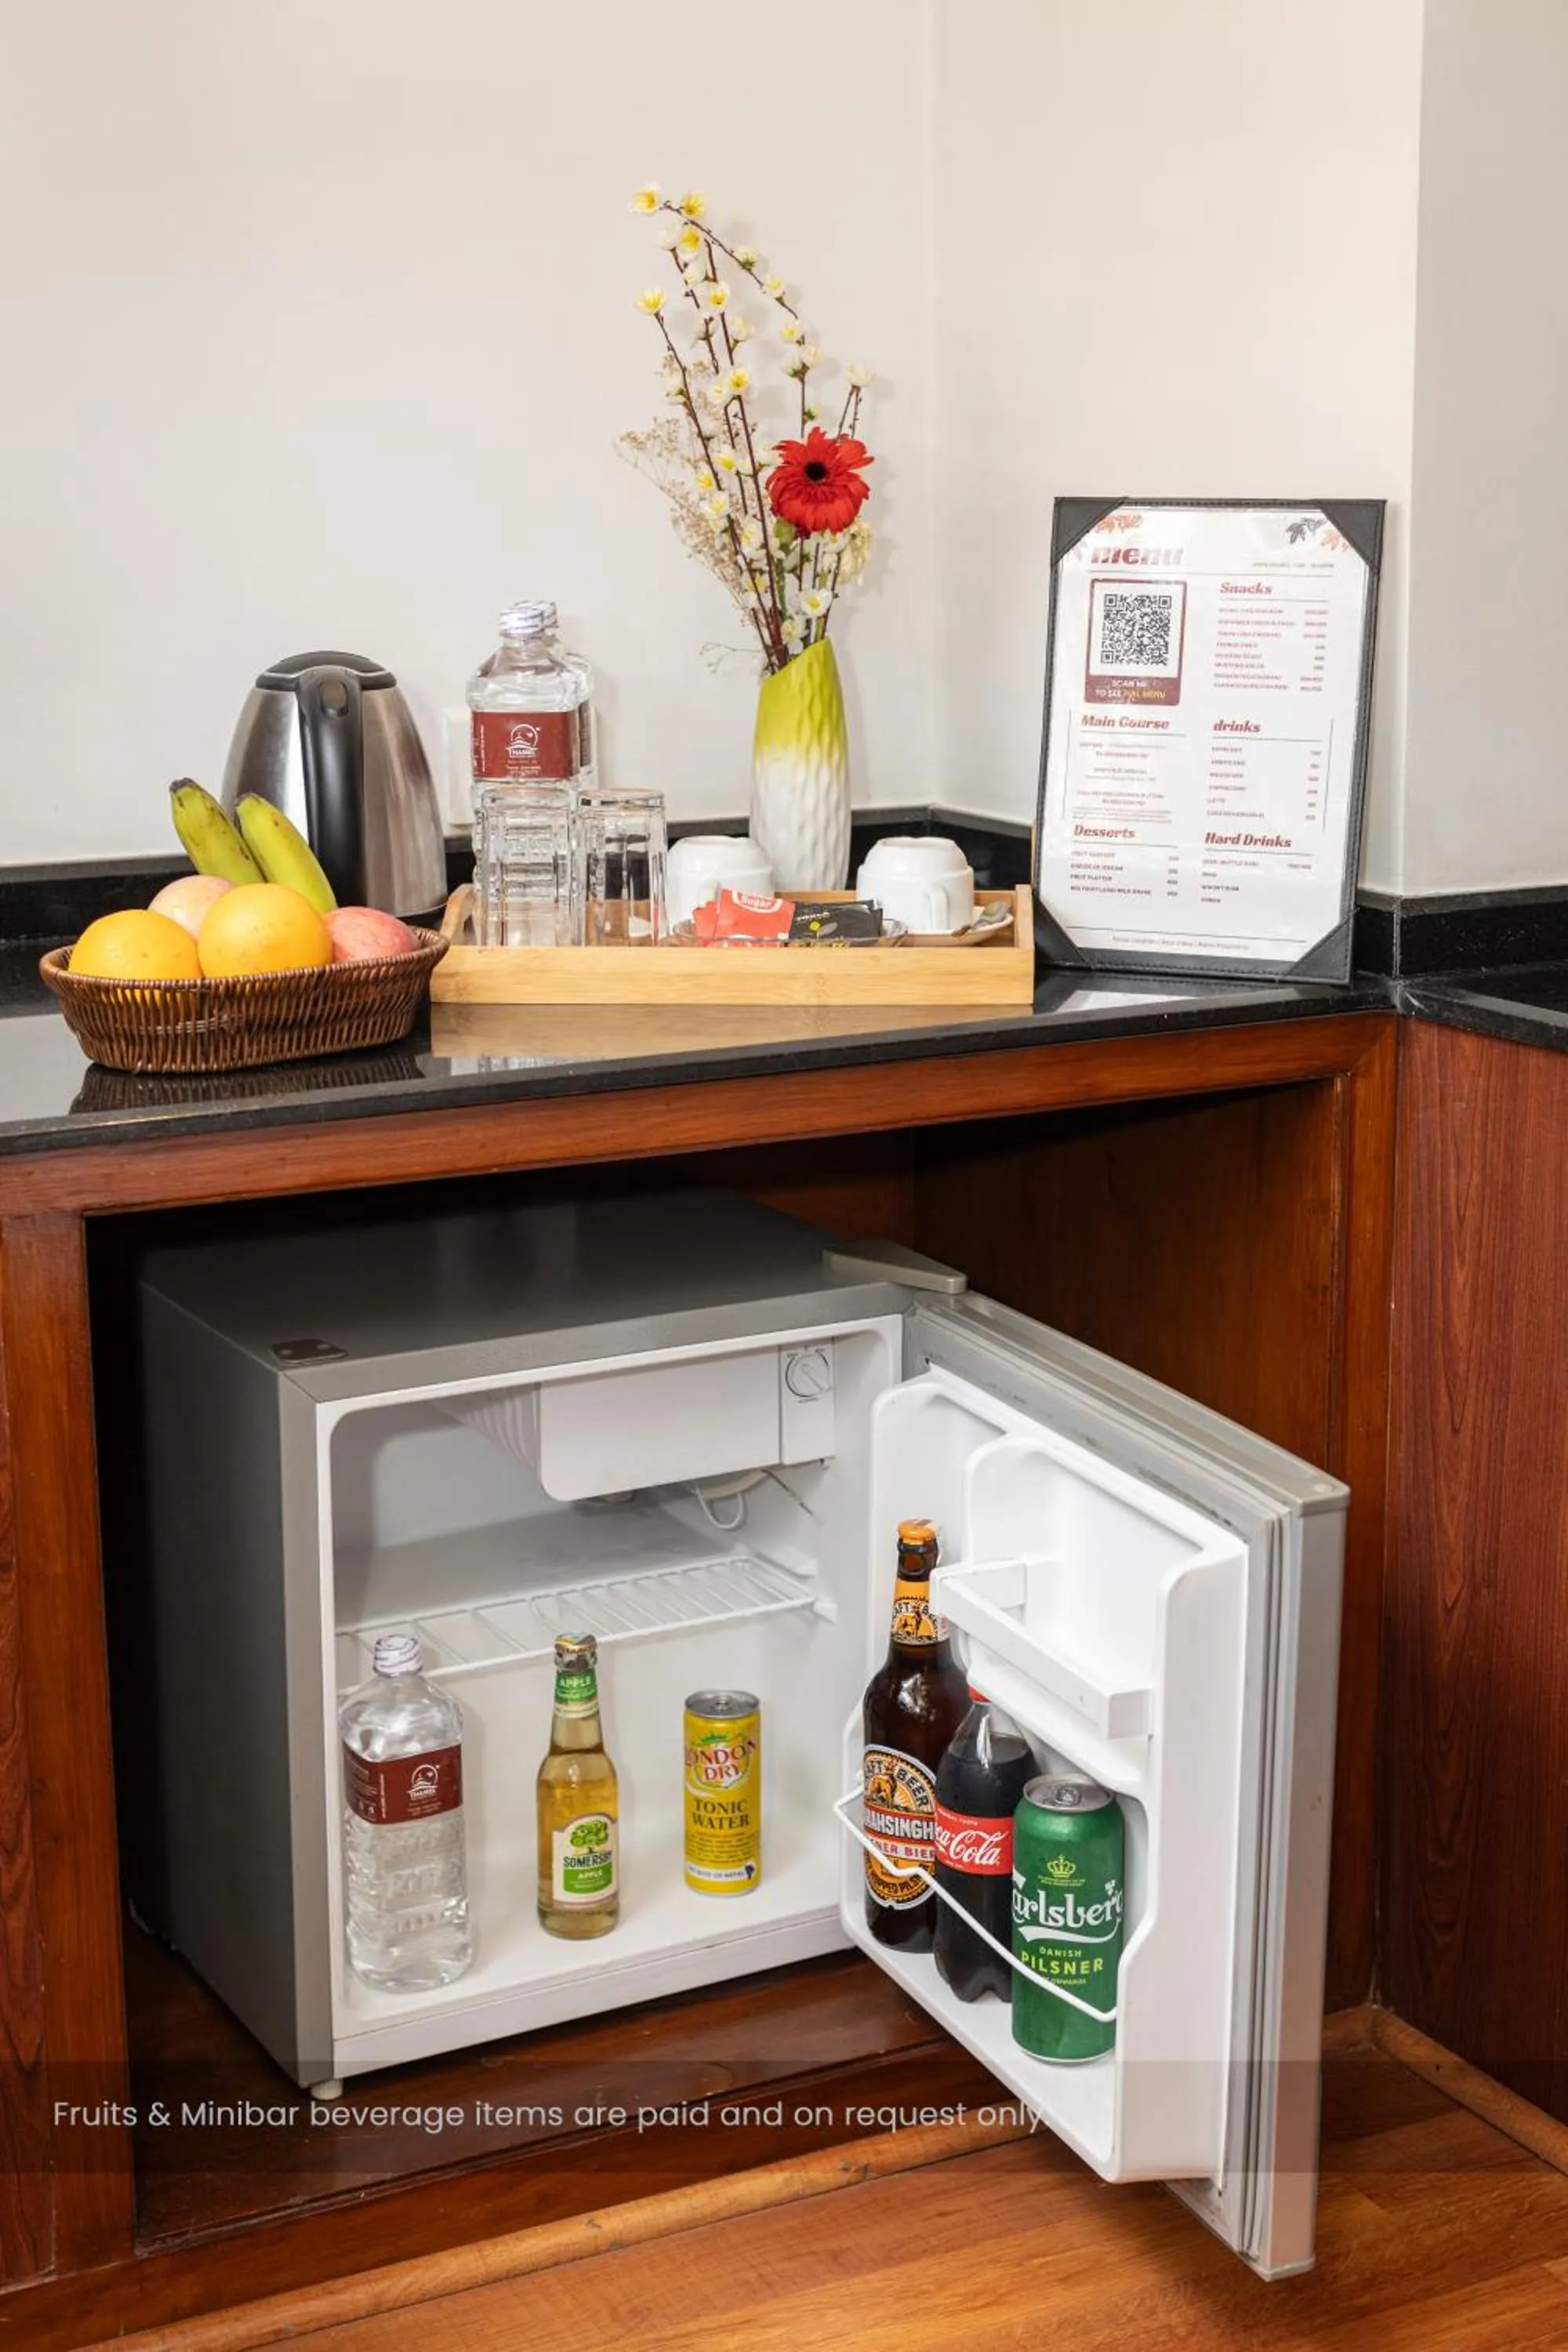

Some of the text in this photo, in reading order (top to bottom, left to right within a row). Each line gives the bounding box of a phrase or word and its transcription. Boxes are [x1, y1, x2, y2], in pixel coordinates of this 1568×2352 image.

[1090, 547, 1184, 565] menu
[1220, 582, 1273, 594] Snacks
[1081, 714, 1170, 729] Main Course
[1213, 720, 1261, 732] drinks
[1073, 825, 1135, 838] Desserts
[1205, 832, 1292, 848] Hard Drinks
[704, 1763, 739, 1780] DRY
[896, 1768, 930, 1806] BEER
[694, 1798, 747, 1815] TONIC
[691, 1812, 750, 1830] WATER
[1039, 1946, 1082, 1958] DANISH
[1022, 1951, 1104, 1975] PILSNER
